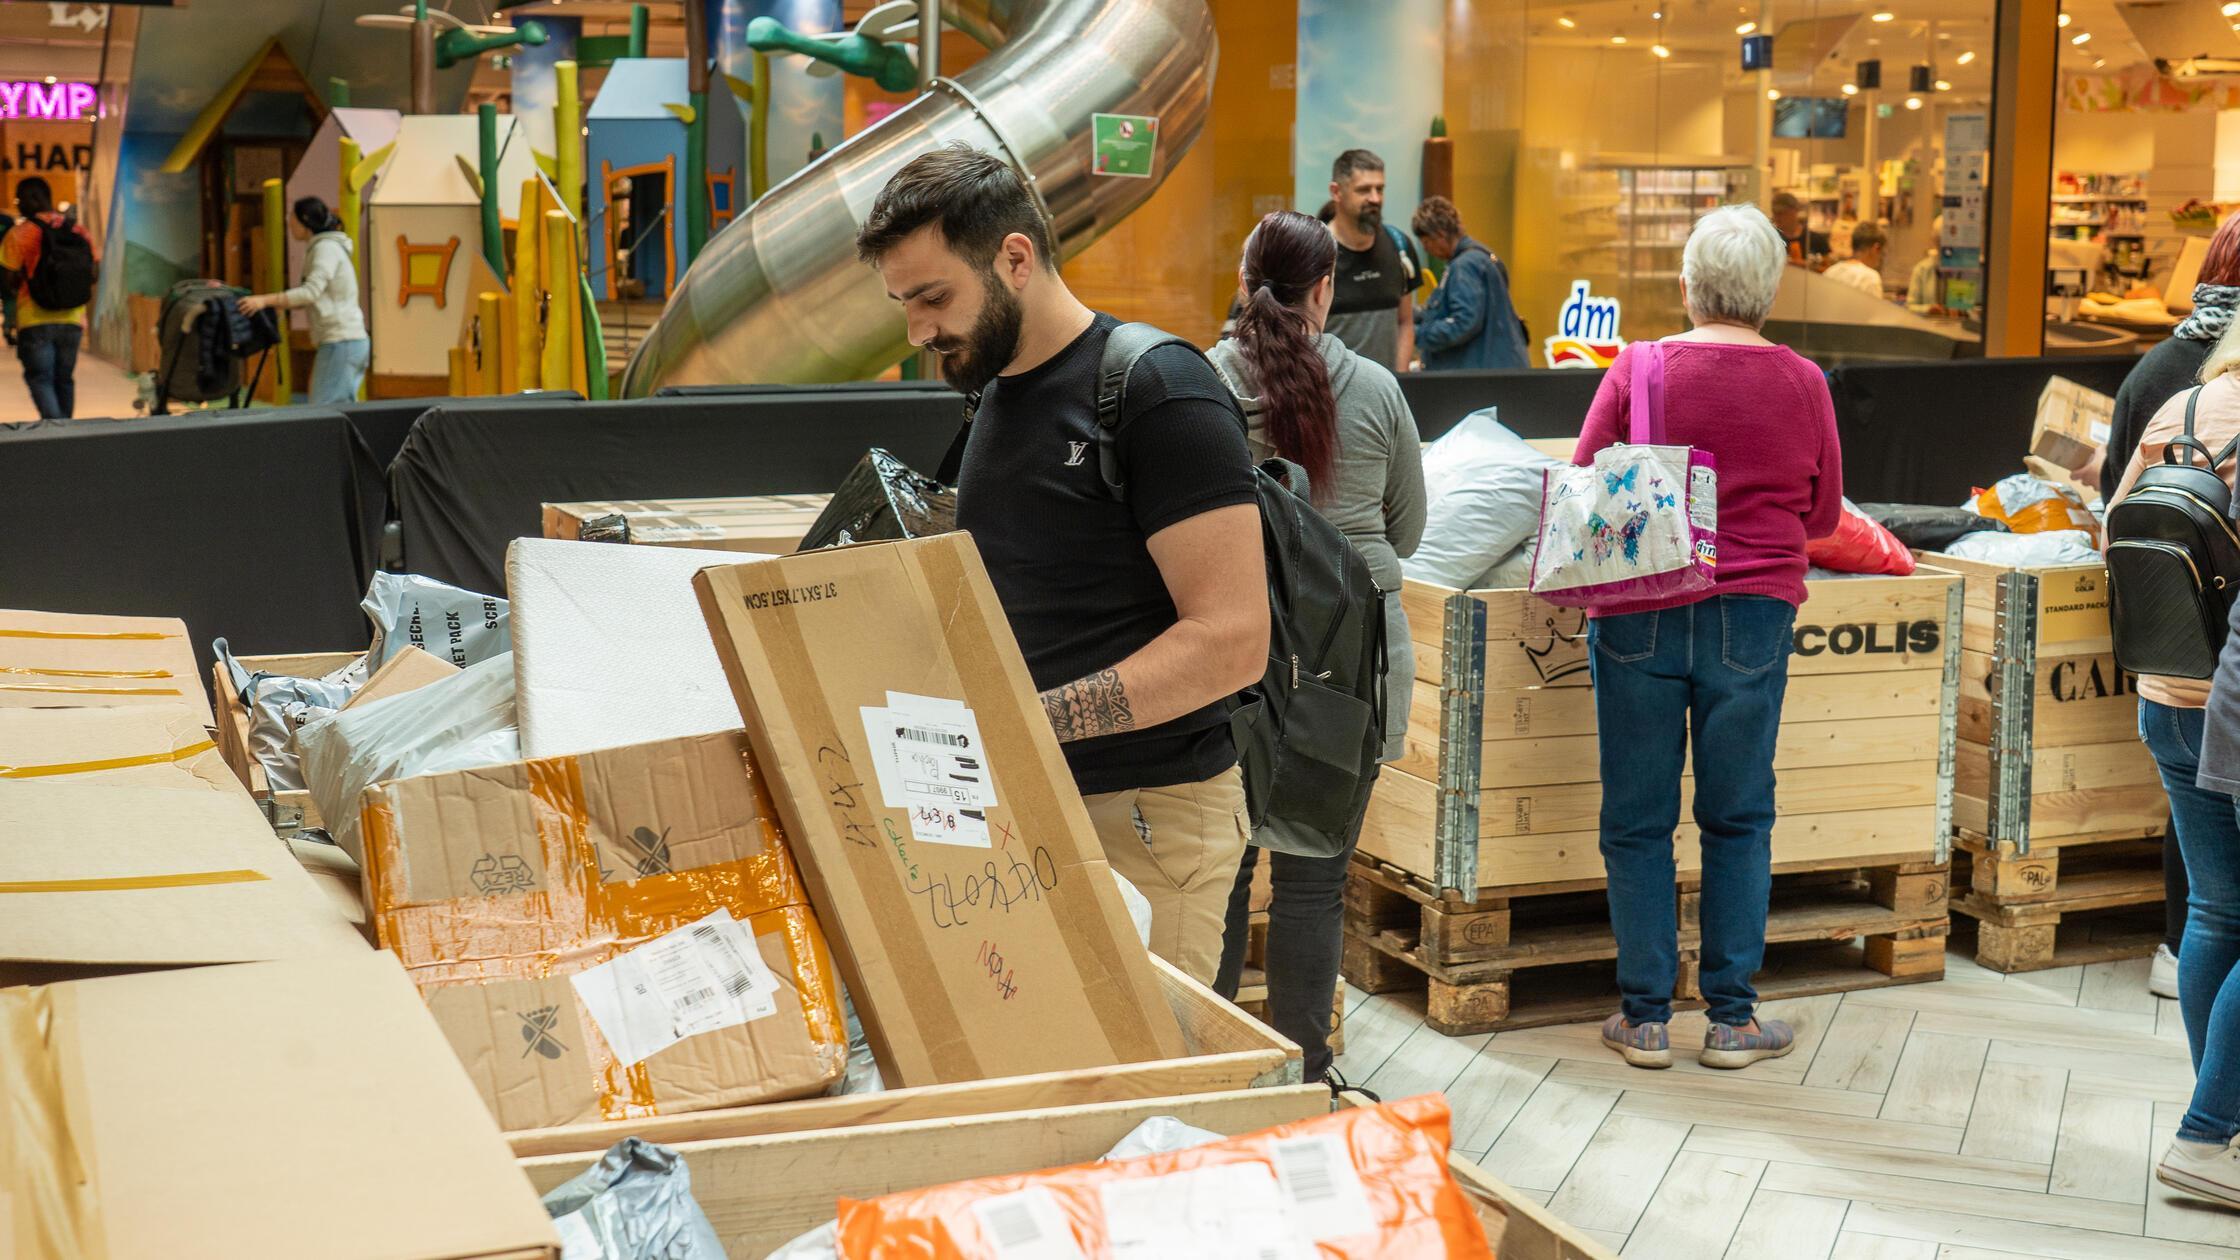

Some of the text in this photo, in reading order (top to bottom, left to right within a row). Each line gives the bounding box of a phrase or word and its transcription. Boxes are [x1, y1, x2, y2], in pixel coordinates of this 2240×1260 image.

[0, 81, 97, 119] YMP
[1563, 287, 1615, 339] dm
[743, 582, 838, 610] 37.5X1.7X57.5CM
[2044, 602, 2085, 614] STANDARD
[445, 611, 462, 645] PACK
[1793, 620, 1940, 657] COLIS
